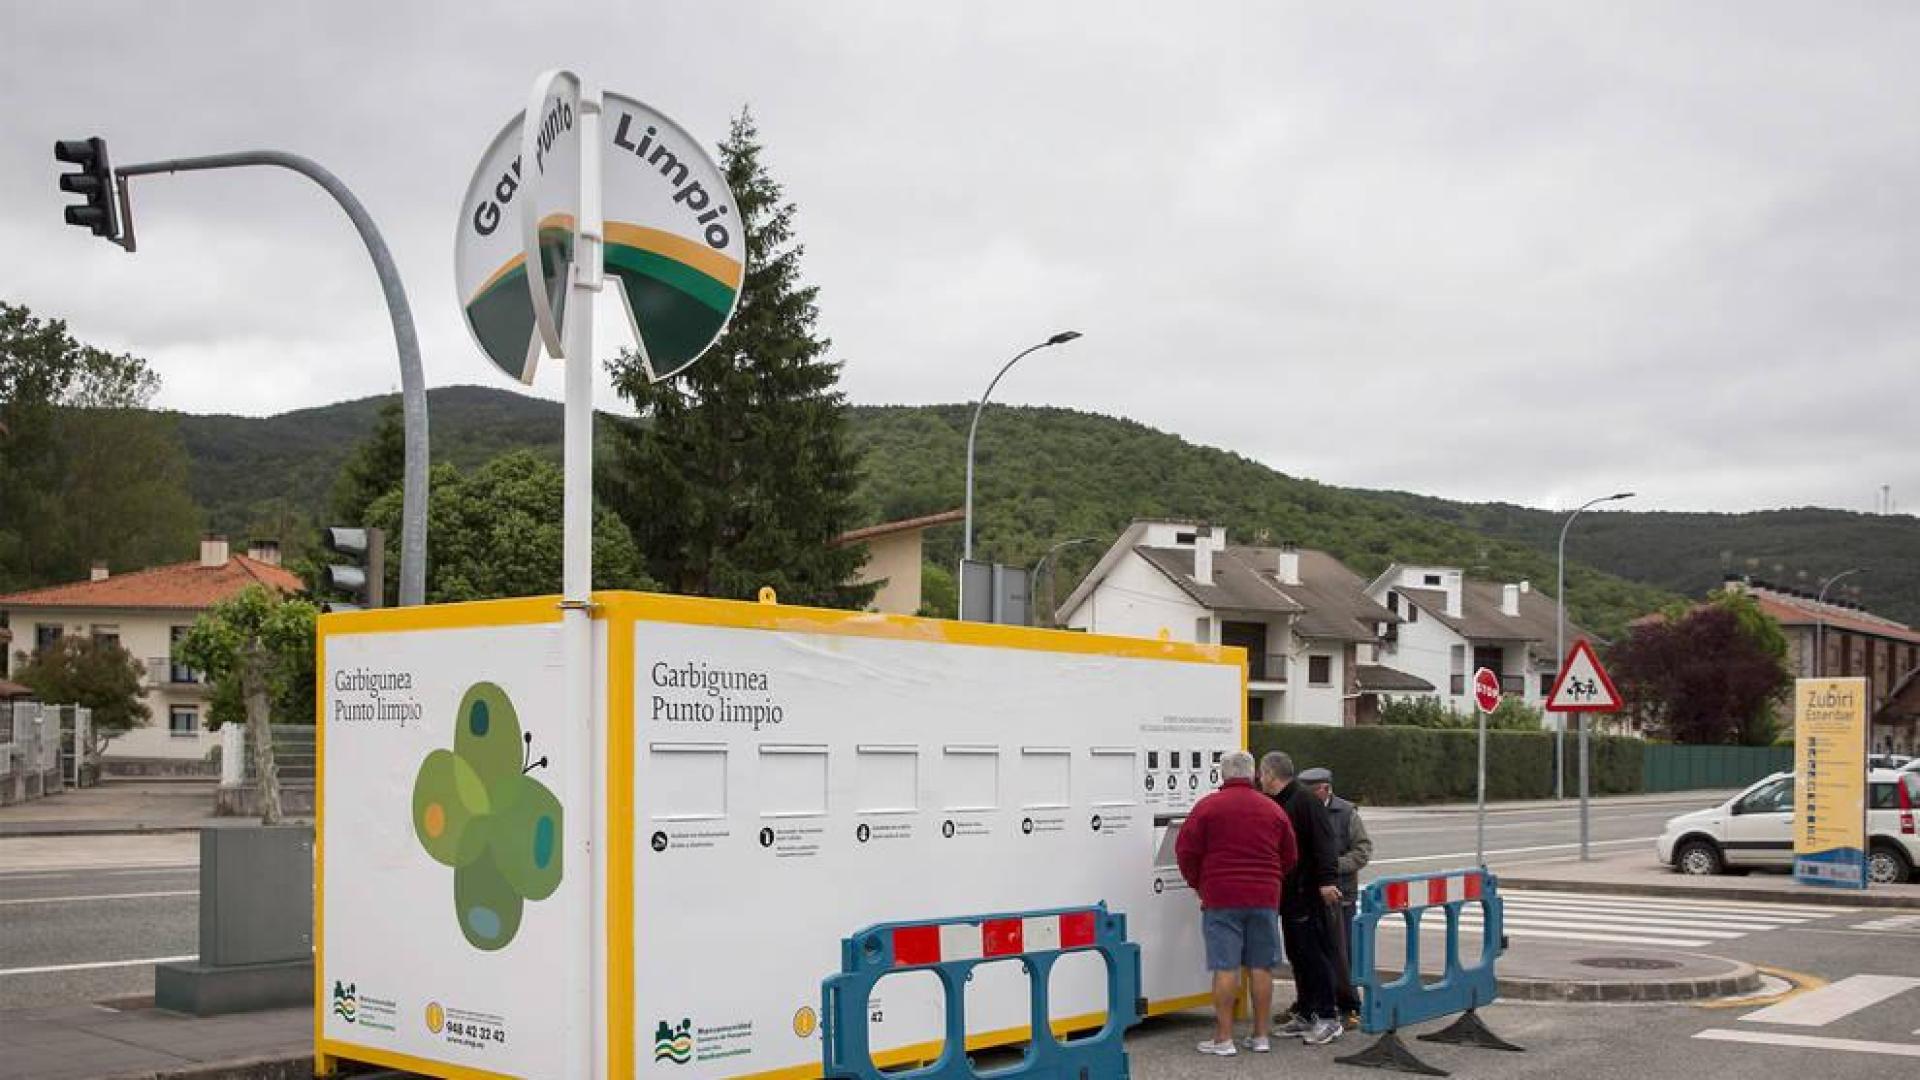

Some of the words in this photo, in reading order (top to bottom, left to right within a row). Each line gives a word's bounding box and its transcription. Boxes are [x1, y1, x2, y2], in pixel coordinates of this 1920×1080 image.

[614, 113, 730, 249] Limpio
[335, 667, 412, 698] Garbigunea
[652, 662, 769, 696] Garbigunea
[1477, 682, 1498, 698] STOP
[335, 699, 375, 721] Punto
[377, 697, 423, 727] limpio
[652, 696, 715, 722] Punto
[719, 697, 784, 731] limpio
[1807, 690, 1853, 709] Zubiri
[465, 1025, 478, 1038] 42
[493, 1030, 505, 1043] 42
